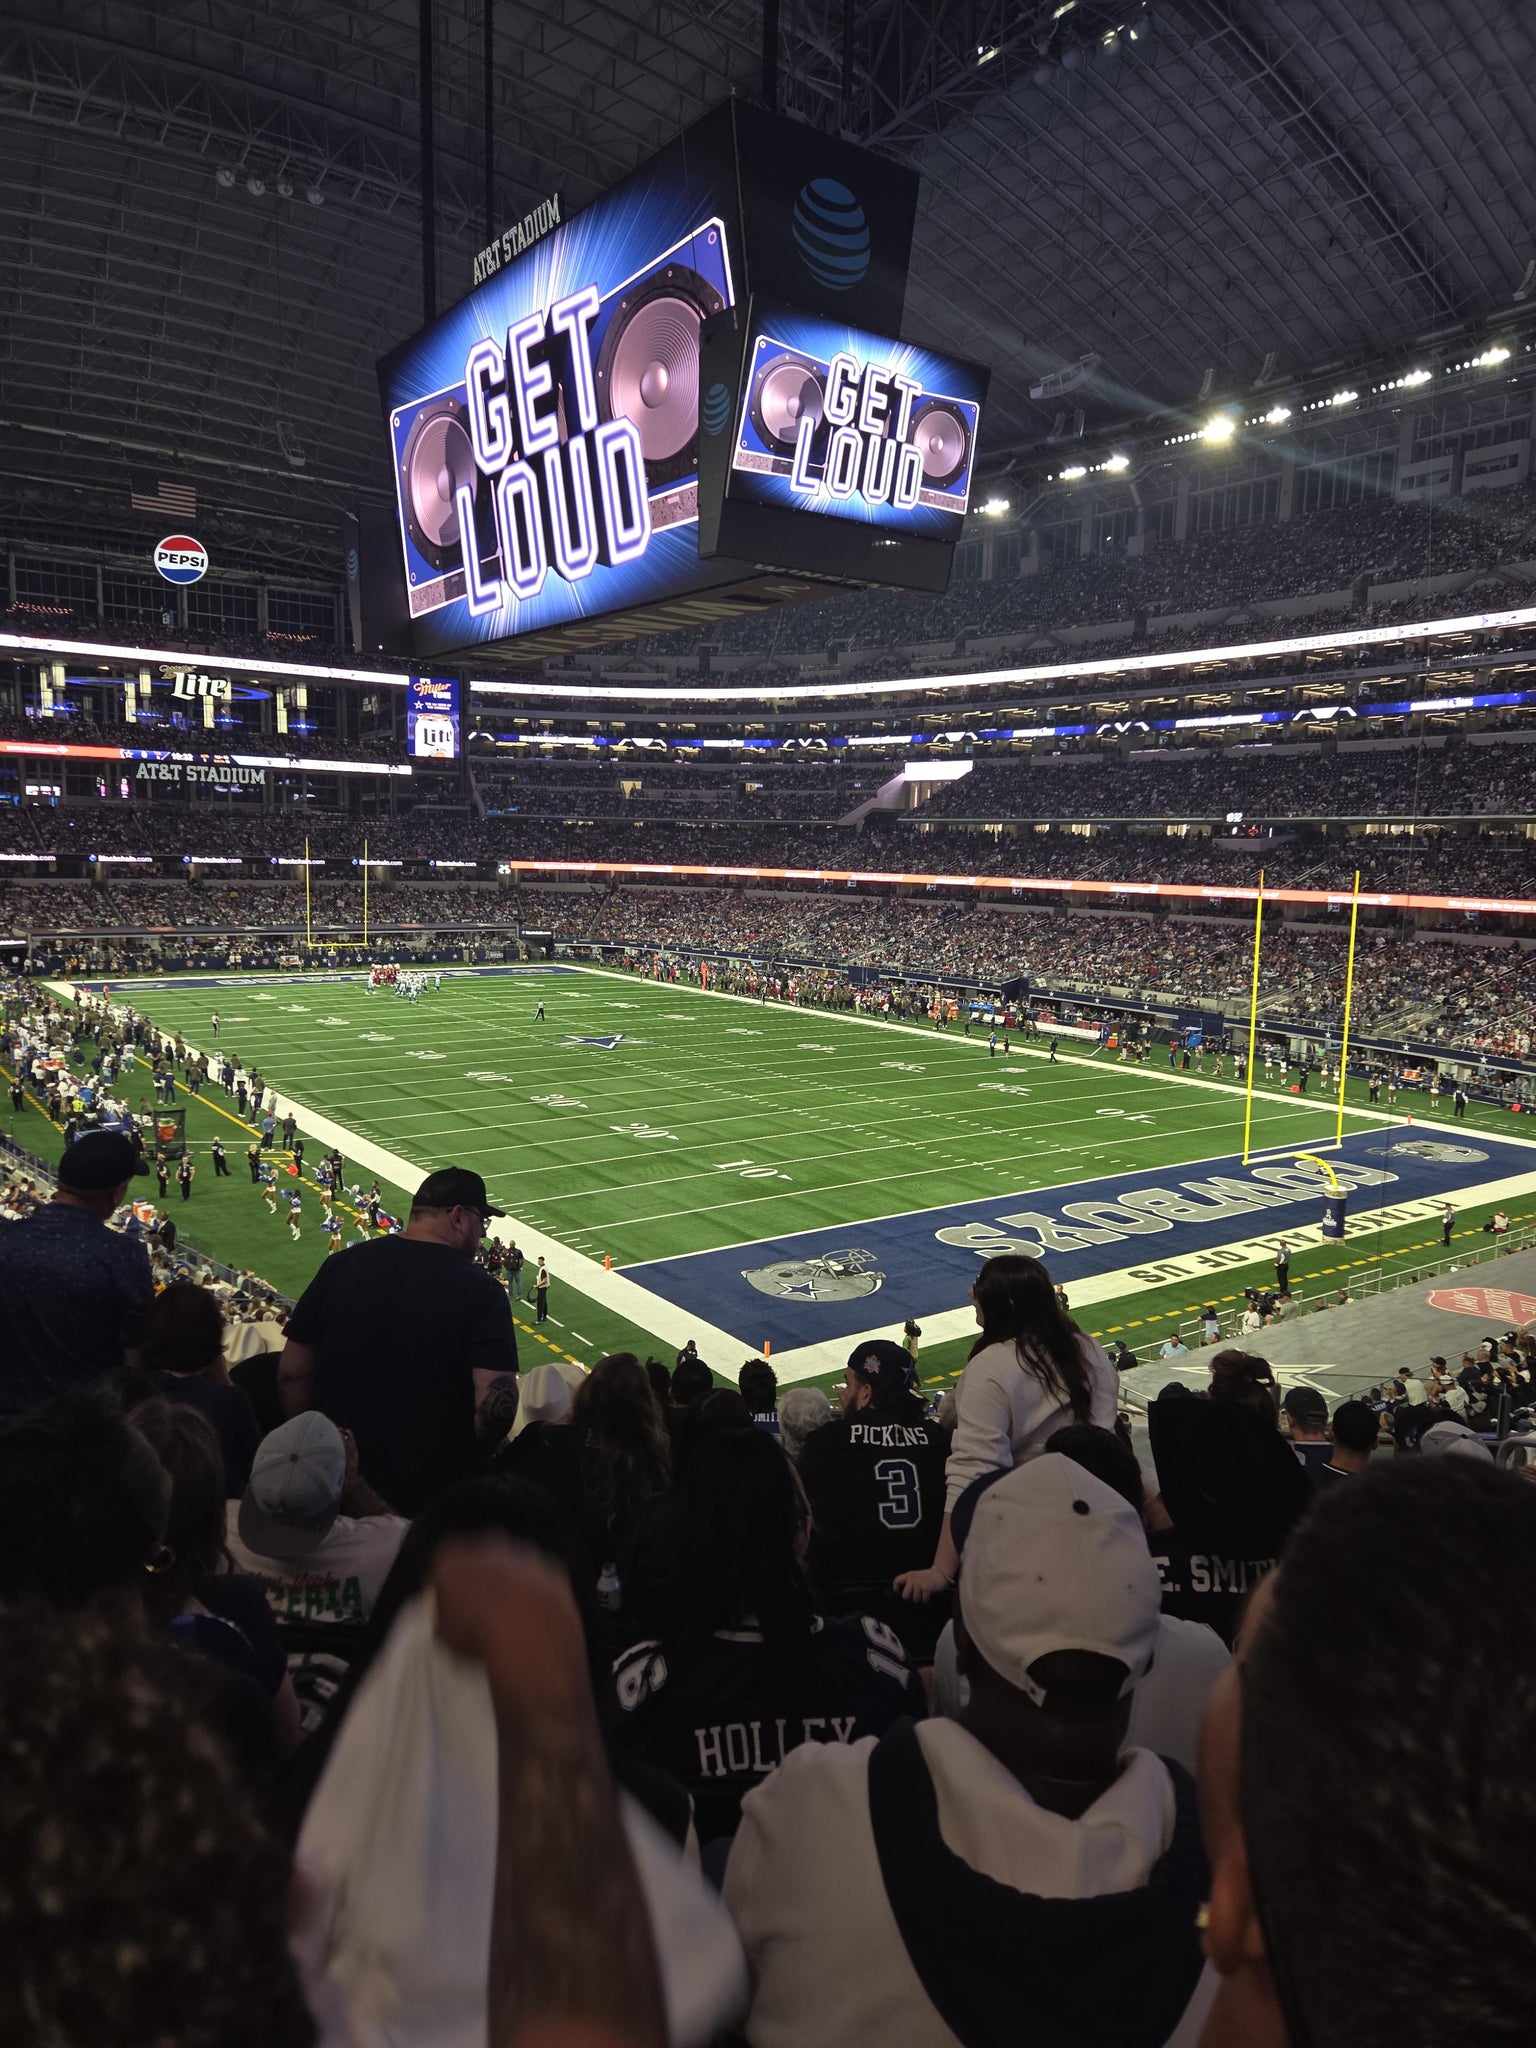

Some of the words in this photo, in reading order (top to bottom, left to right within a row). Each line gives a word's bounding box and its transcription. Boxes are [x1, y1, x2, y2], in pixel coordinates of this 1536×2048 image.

[473, 240, 500, 286] AT&T
[503, 194, 561, 263] STADIUM
[464, 283, 602, 477] GET
[824, 351, 922, 444] GET
[790, 416, 924, 510] LOUD
[456, 415, 652, 619] LOUD
[158, 551, 205, 568] PEPSI
[171, 671, 228, 701] Lite
[136, 762, 182, 781] AT&T
[186, 764, 266, 785] STADIUM
[608, 1122, 671, 1139] 20
[710, 1159, 780, 1179] 10
[934, 1159, 1400, 1260] COWBOYS
[1127, 1264, 1194, 1284] US
[1195, 1250, 1250, 1268] OF
[849, 1423, 929, 1448] PICKENS
[874, 1458, 922, 1530] 3
[1190, 1554, 1277, 1594] SMIT
